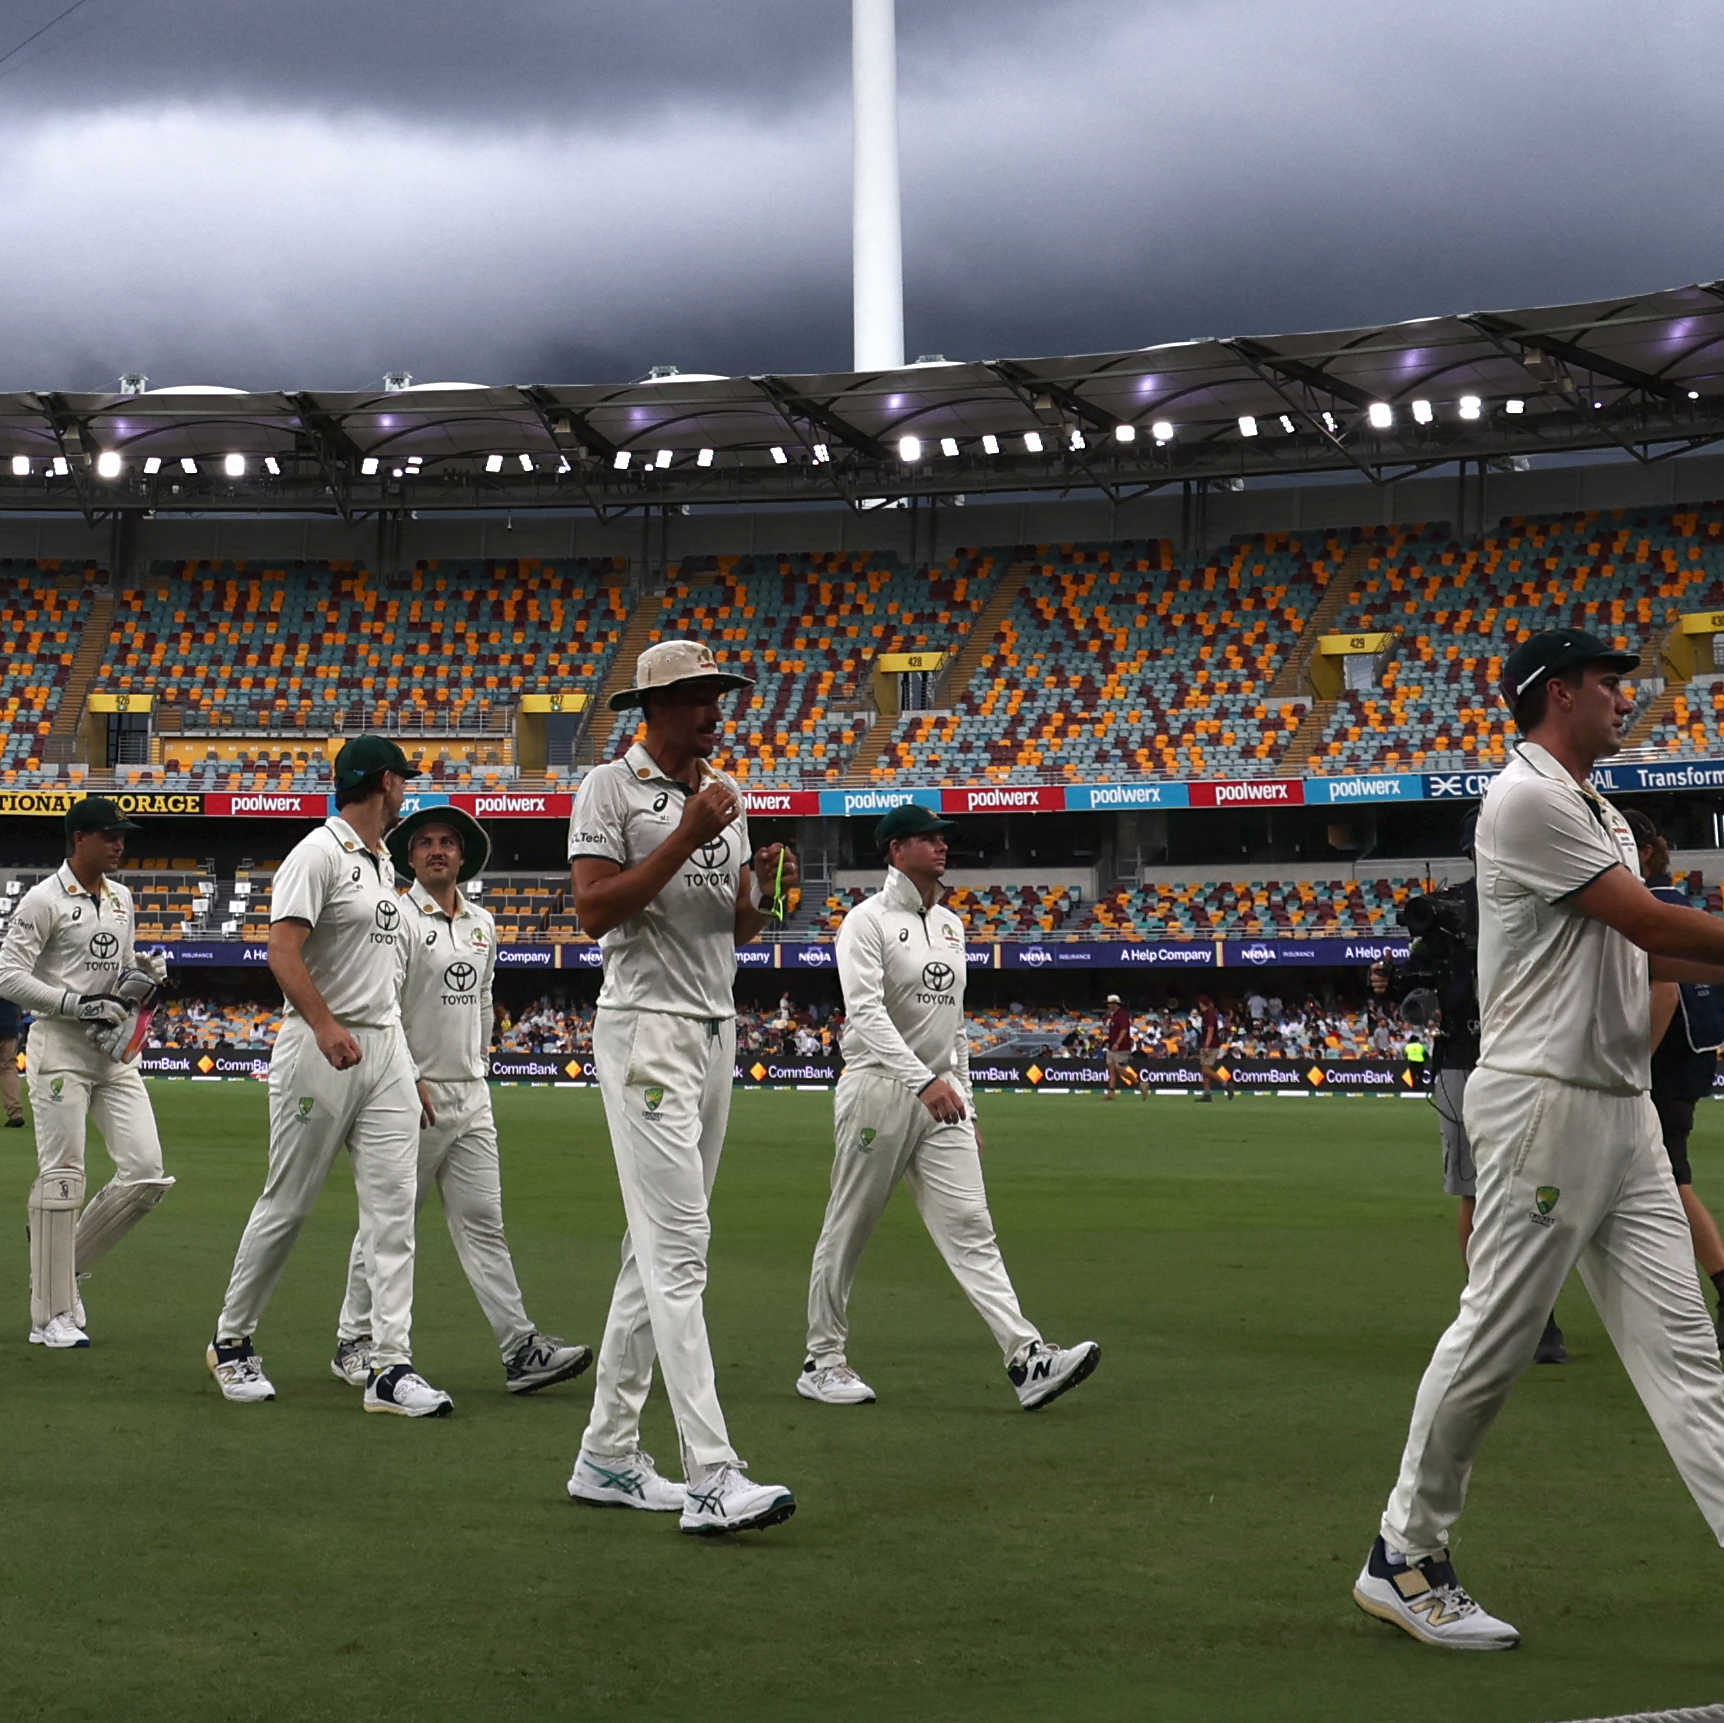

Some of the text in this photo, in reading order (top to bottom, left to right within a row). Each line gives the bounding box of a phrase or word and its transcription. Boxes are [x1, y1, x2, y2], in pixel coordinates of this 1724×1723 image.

[1090, 784, 1160, 808] poolwerx
[1215, 782, 1288, 805] poolwerx
[1329, 777, 1401, 802] poolwerx
[231, 794, 301, 815] poolwerx
[476, 795, 545, 816] poolwerx
[968, 788, 1039, 811] poolwerx
[685, 873, 729, 887] TOYOTA
[1121, 948, 1211, 964] A Help Company
[916, 992, 956, 1007] TOYOTA
[492, 1062, 558, 1077] CommBank
[767, 1065, 834, 1079] CommBank
[1232, 1068, 1299, 1084] CommBank
[1326, 1069, 1394, 1085] CommBank
